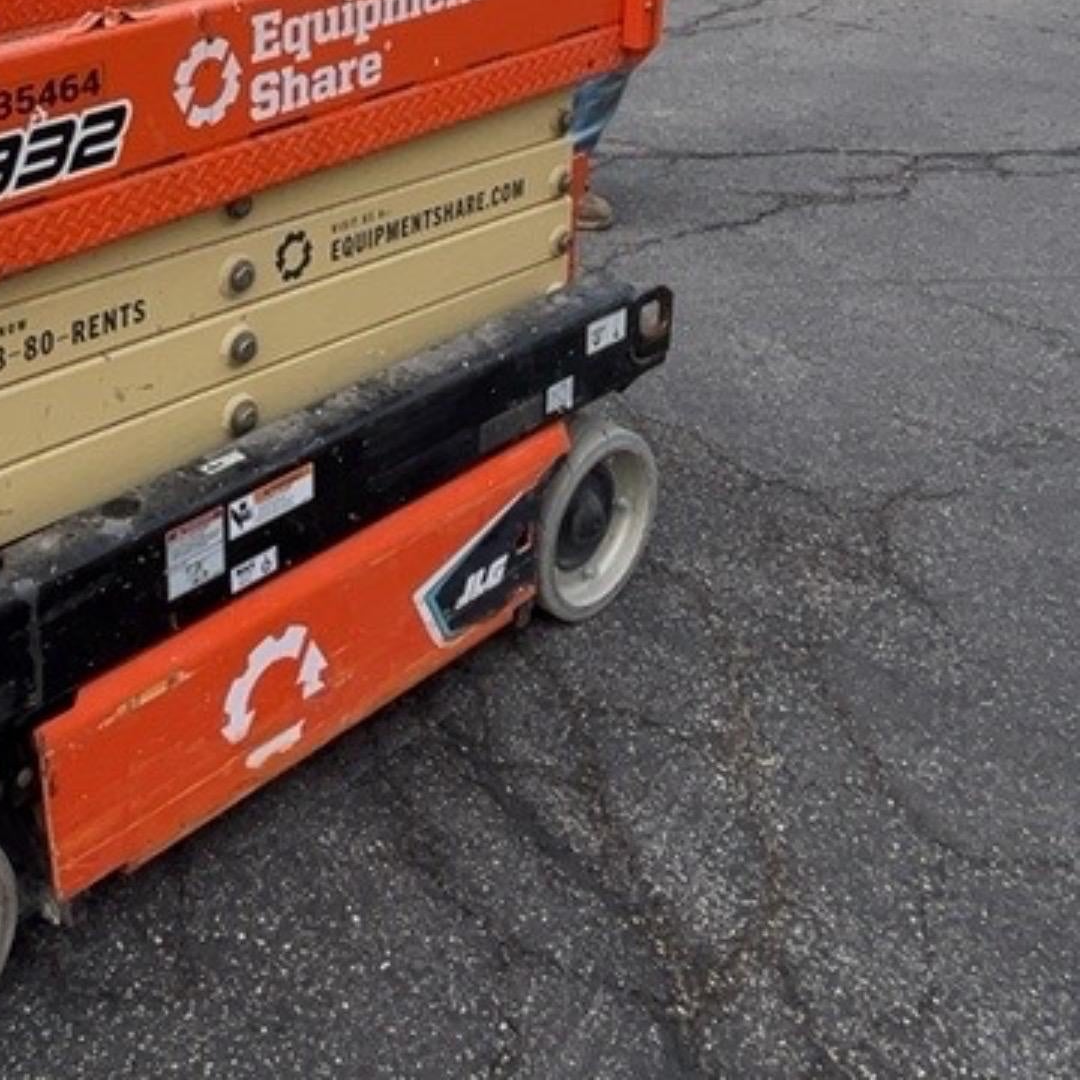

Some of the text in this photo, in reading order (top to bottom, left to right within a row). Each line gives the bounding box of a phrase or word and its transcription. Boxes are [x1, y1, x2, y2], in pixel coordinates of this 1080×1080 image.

[250, 50, 382, 122] Share
[330, 178, 525, 261] EQUIPMENTSHARE.COM
[455, 552, 509, 610] JLG
